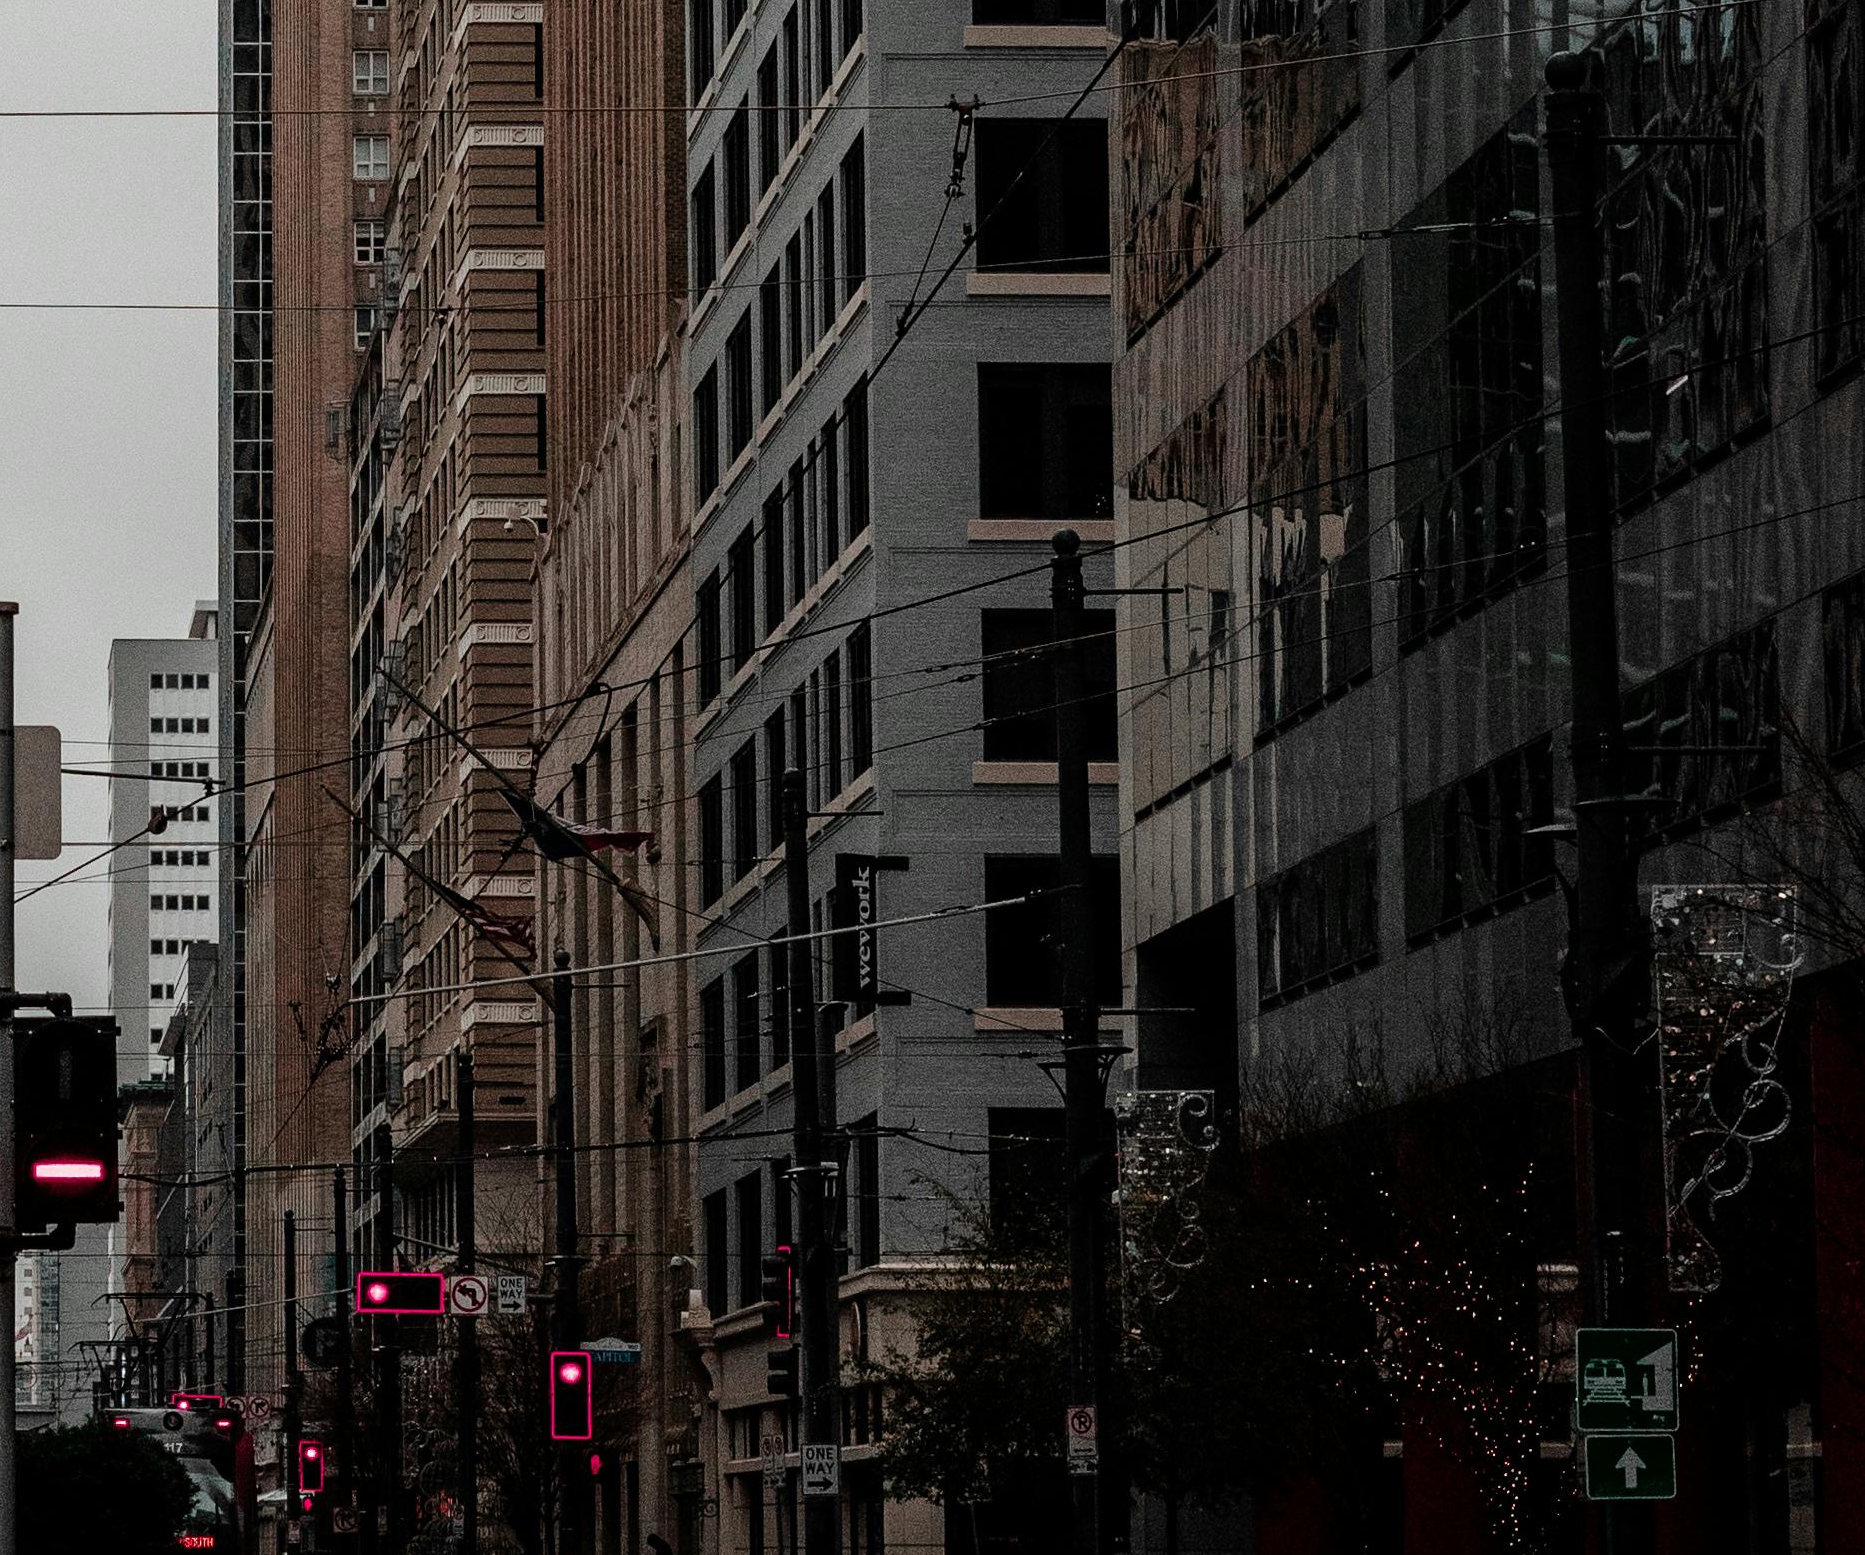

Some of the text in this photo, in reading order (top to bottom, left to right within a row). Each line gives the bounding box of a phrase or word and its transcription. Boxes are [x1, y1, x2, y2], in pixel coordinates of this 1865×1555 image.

[851, 865, 871, 989] wework
[500, 1277, 523, 1288] ONE
[500, 1289, 523, 1299] WAY
[805, 1447, 834, 1460] ONE
[805, 1462, 835, 1475] WAY
[183, 1536, 215, 1548] SOUTH
